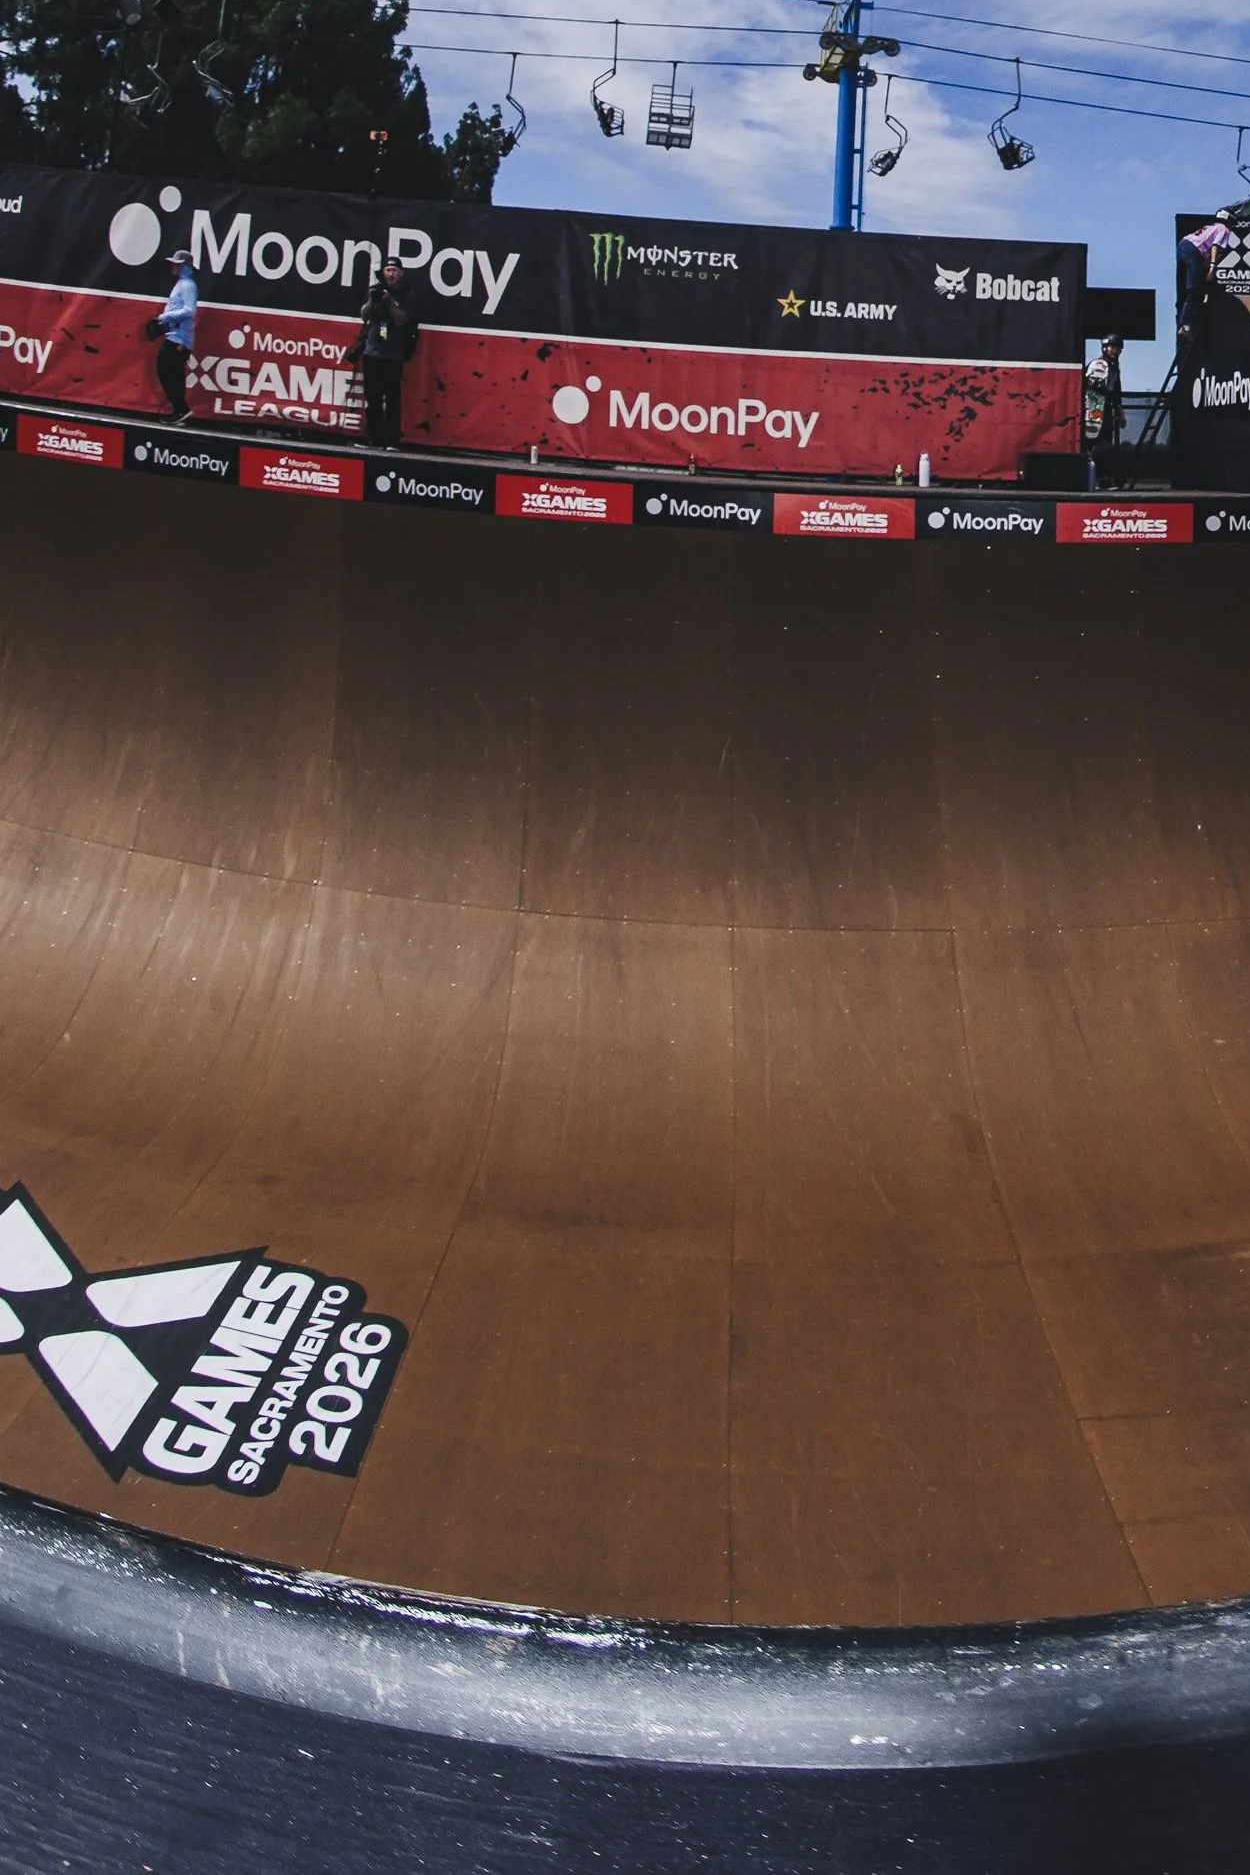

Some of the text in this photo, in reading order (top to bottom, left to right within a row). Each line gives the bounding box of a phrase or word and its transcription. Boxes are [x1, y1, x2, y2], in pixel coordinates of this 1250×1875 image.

[190, 209, 520, 315] MoonPay
[626, 244, 739, 270] MONSTER
[643, 268, 720, 281] ENERGY
[975, 272, 1060, 302] Bobcat
[809, 300, 898, 321] U.S. ARMY
[253, 331, 347, 365] MoonPay
[213, 397, 363, 430] LEAGUE
[609, 389, 820, 448] MoonPay
[37, 433, 104, 455] XGAMES
[154, 447, 229, 476] MoonPay
[263, 465, 340, 486] XGAMES
[398, 477, 483, 505] MoonPay
[522, 492, 607, 512] XGAMES
[550, 485, 586, 495] MoonPay
[669, 498, 762, 525] MoonPay
[799, 510, 888, 526] XGAMES
[829, 501, 867, 512] MoonPay
[1110, 509, 1147, 518] MoonPay
[952, 512, 1044, 535] MoonPay
[1082, 519, 1168, 533] XGAMES
[142, 1264, 316, 1474] GAMES
[226, 1284, 350, 1485] SACRAMENTO
[288, 1322, 392, 1464] 2026
